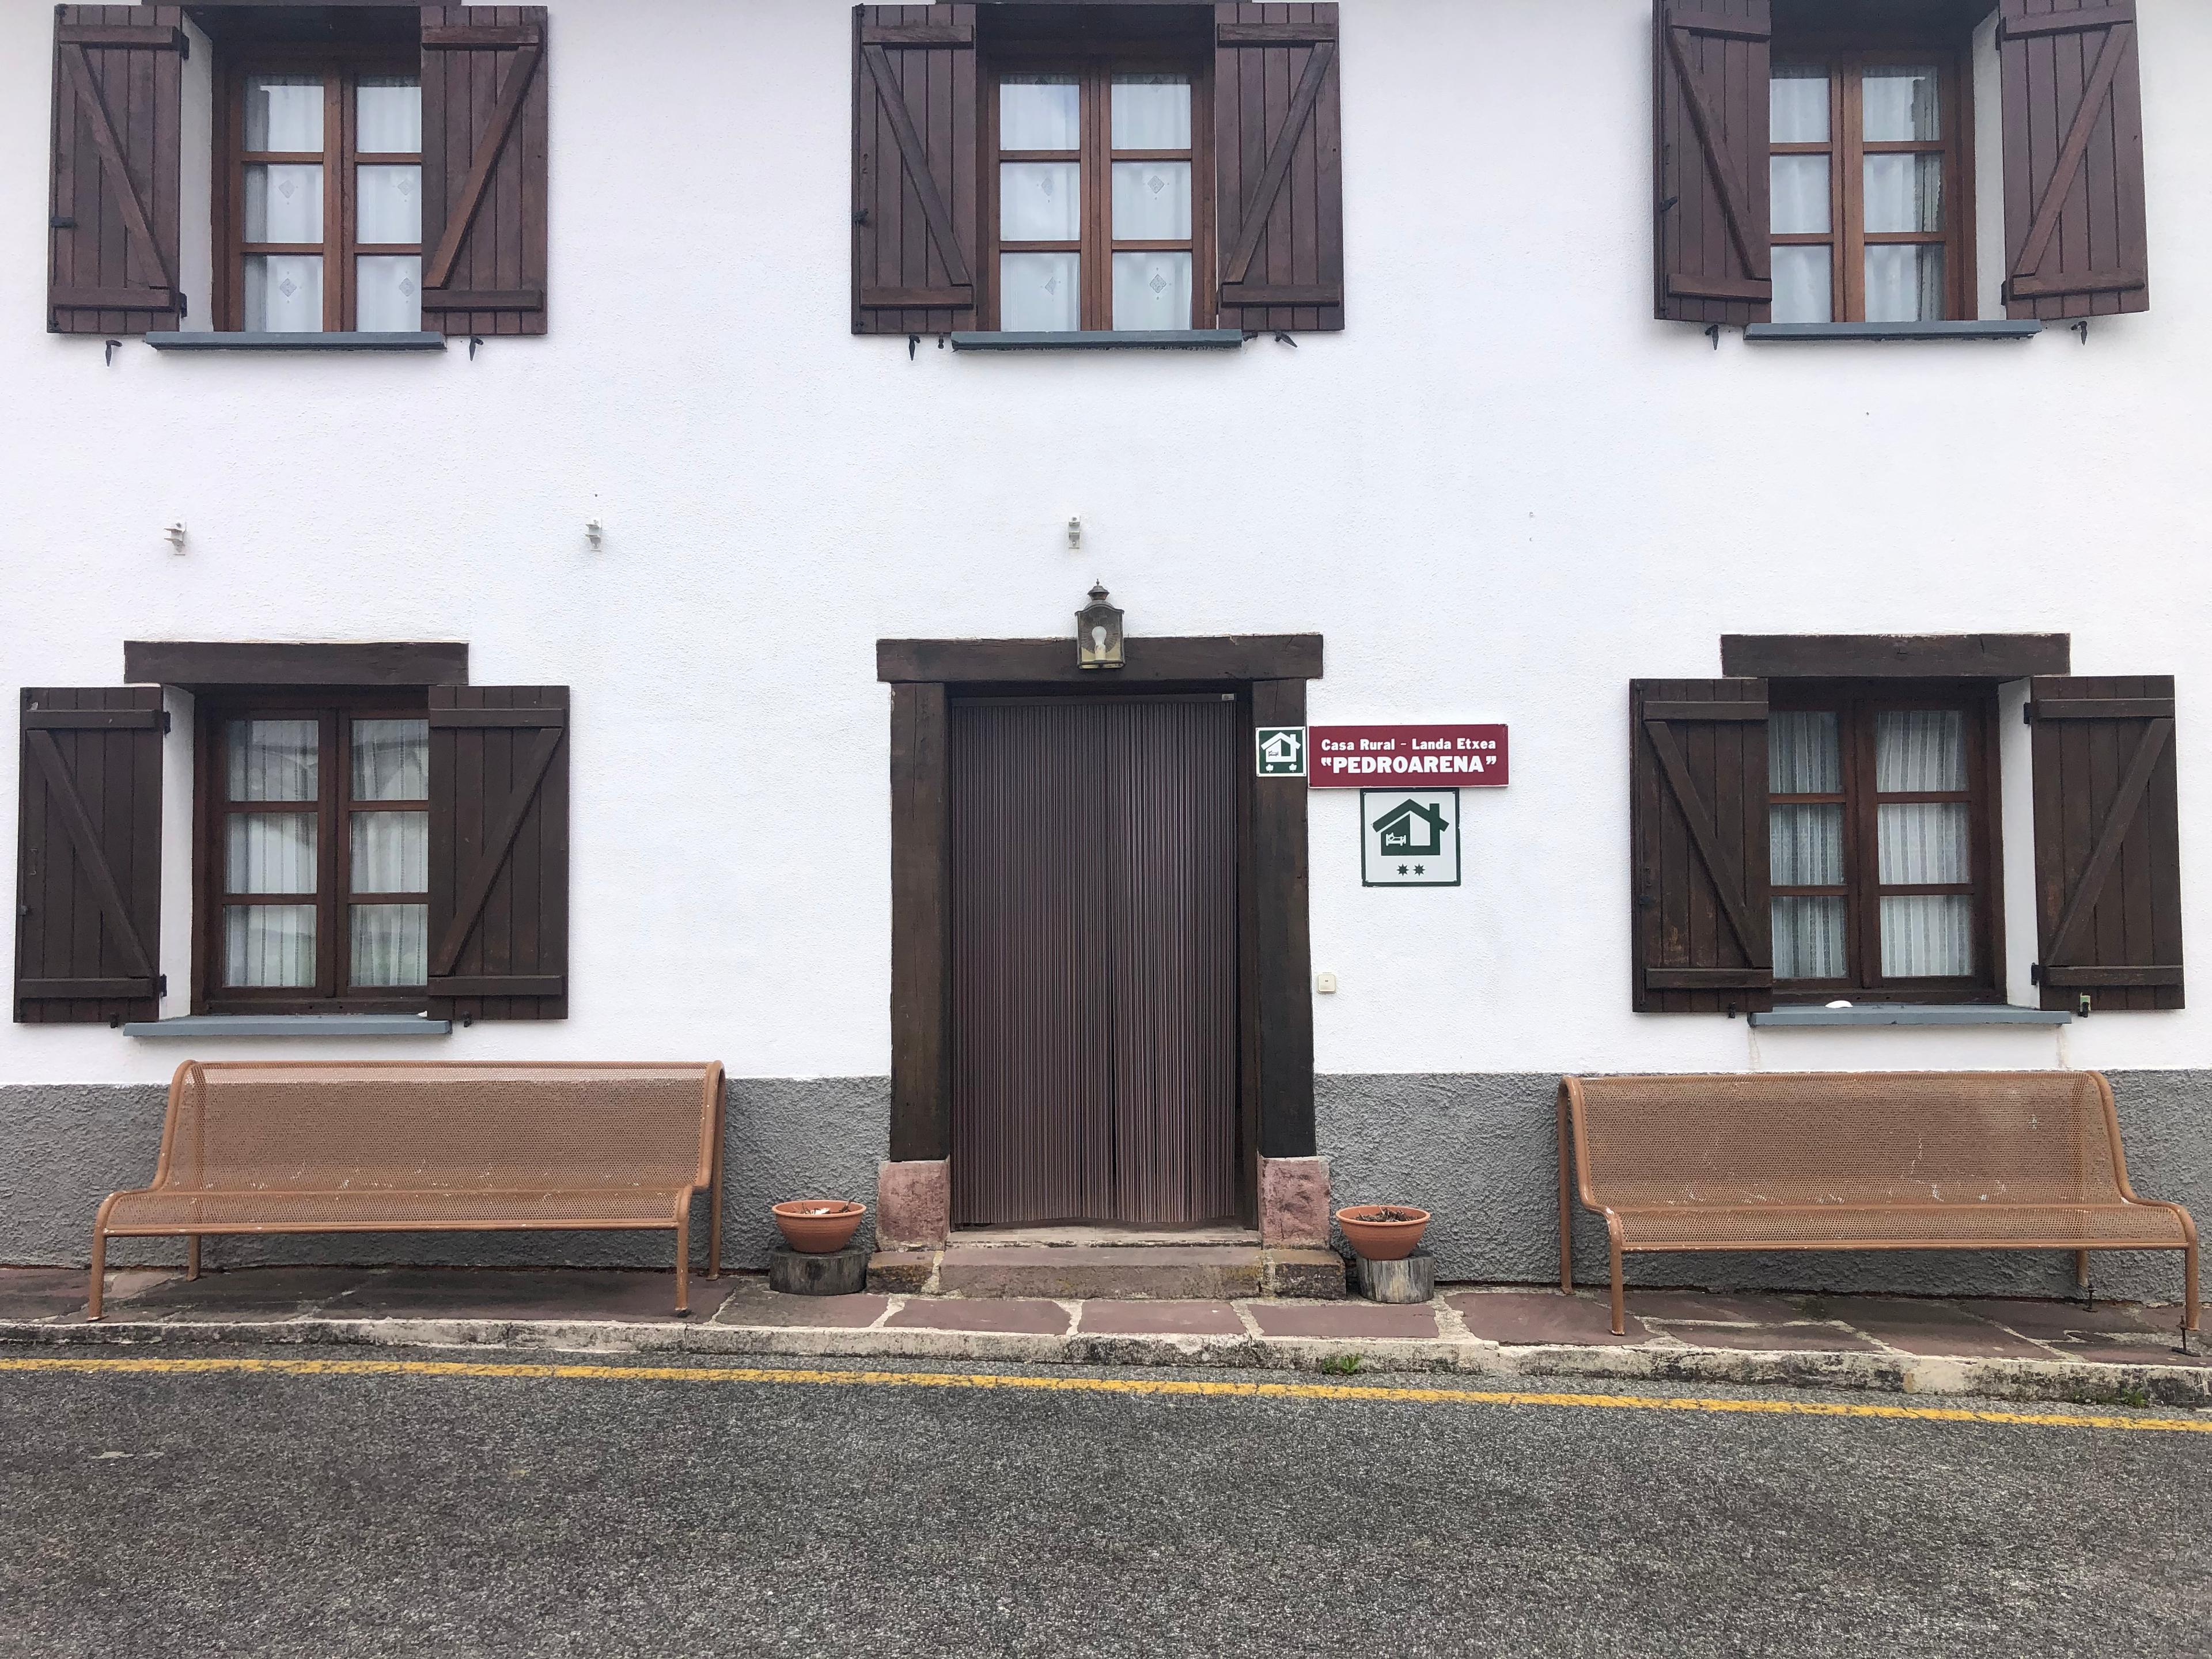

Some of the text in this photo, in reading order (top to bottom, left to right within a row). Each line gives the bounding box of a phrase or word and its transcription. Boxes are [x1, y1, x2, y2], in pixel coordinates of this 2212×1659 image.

[1321, 738, 1355, 751] Casa
[1359, 738, 1395, 751] Rural
[1412, 738, 1452, 750] Landa
[1457, 737, 1496, 749] Etxea
